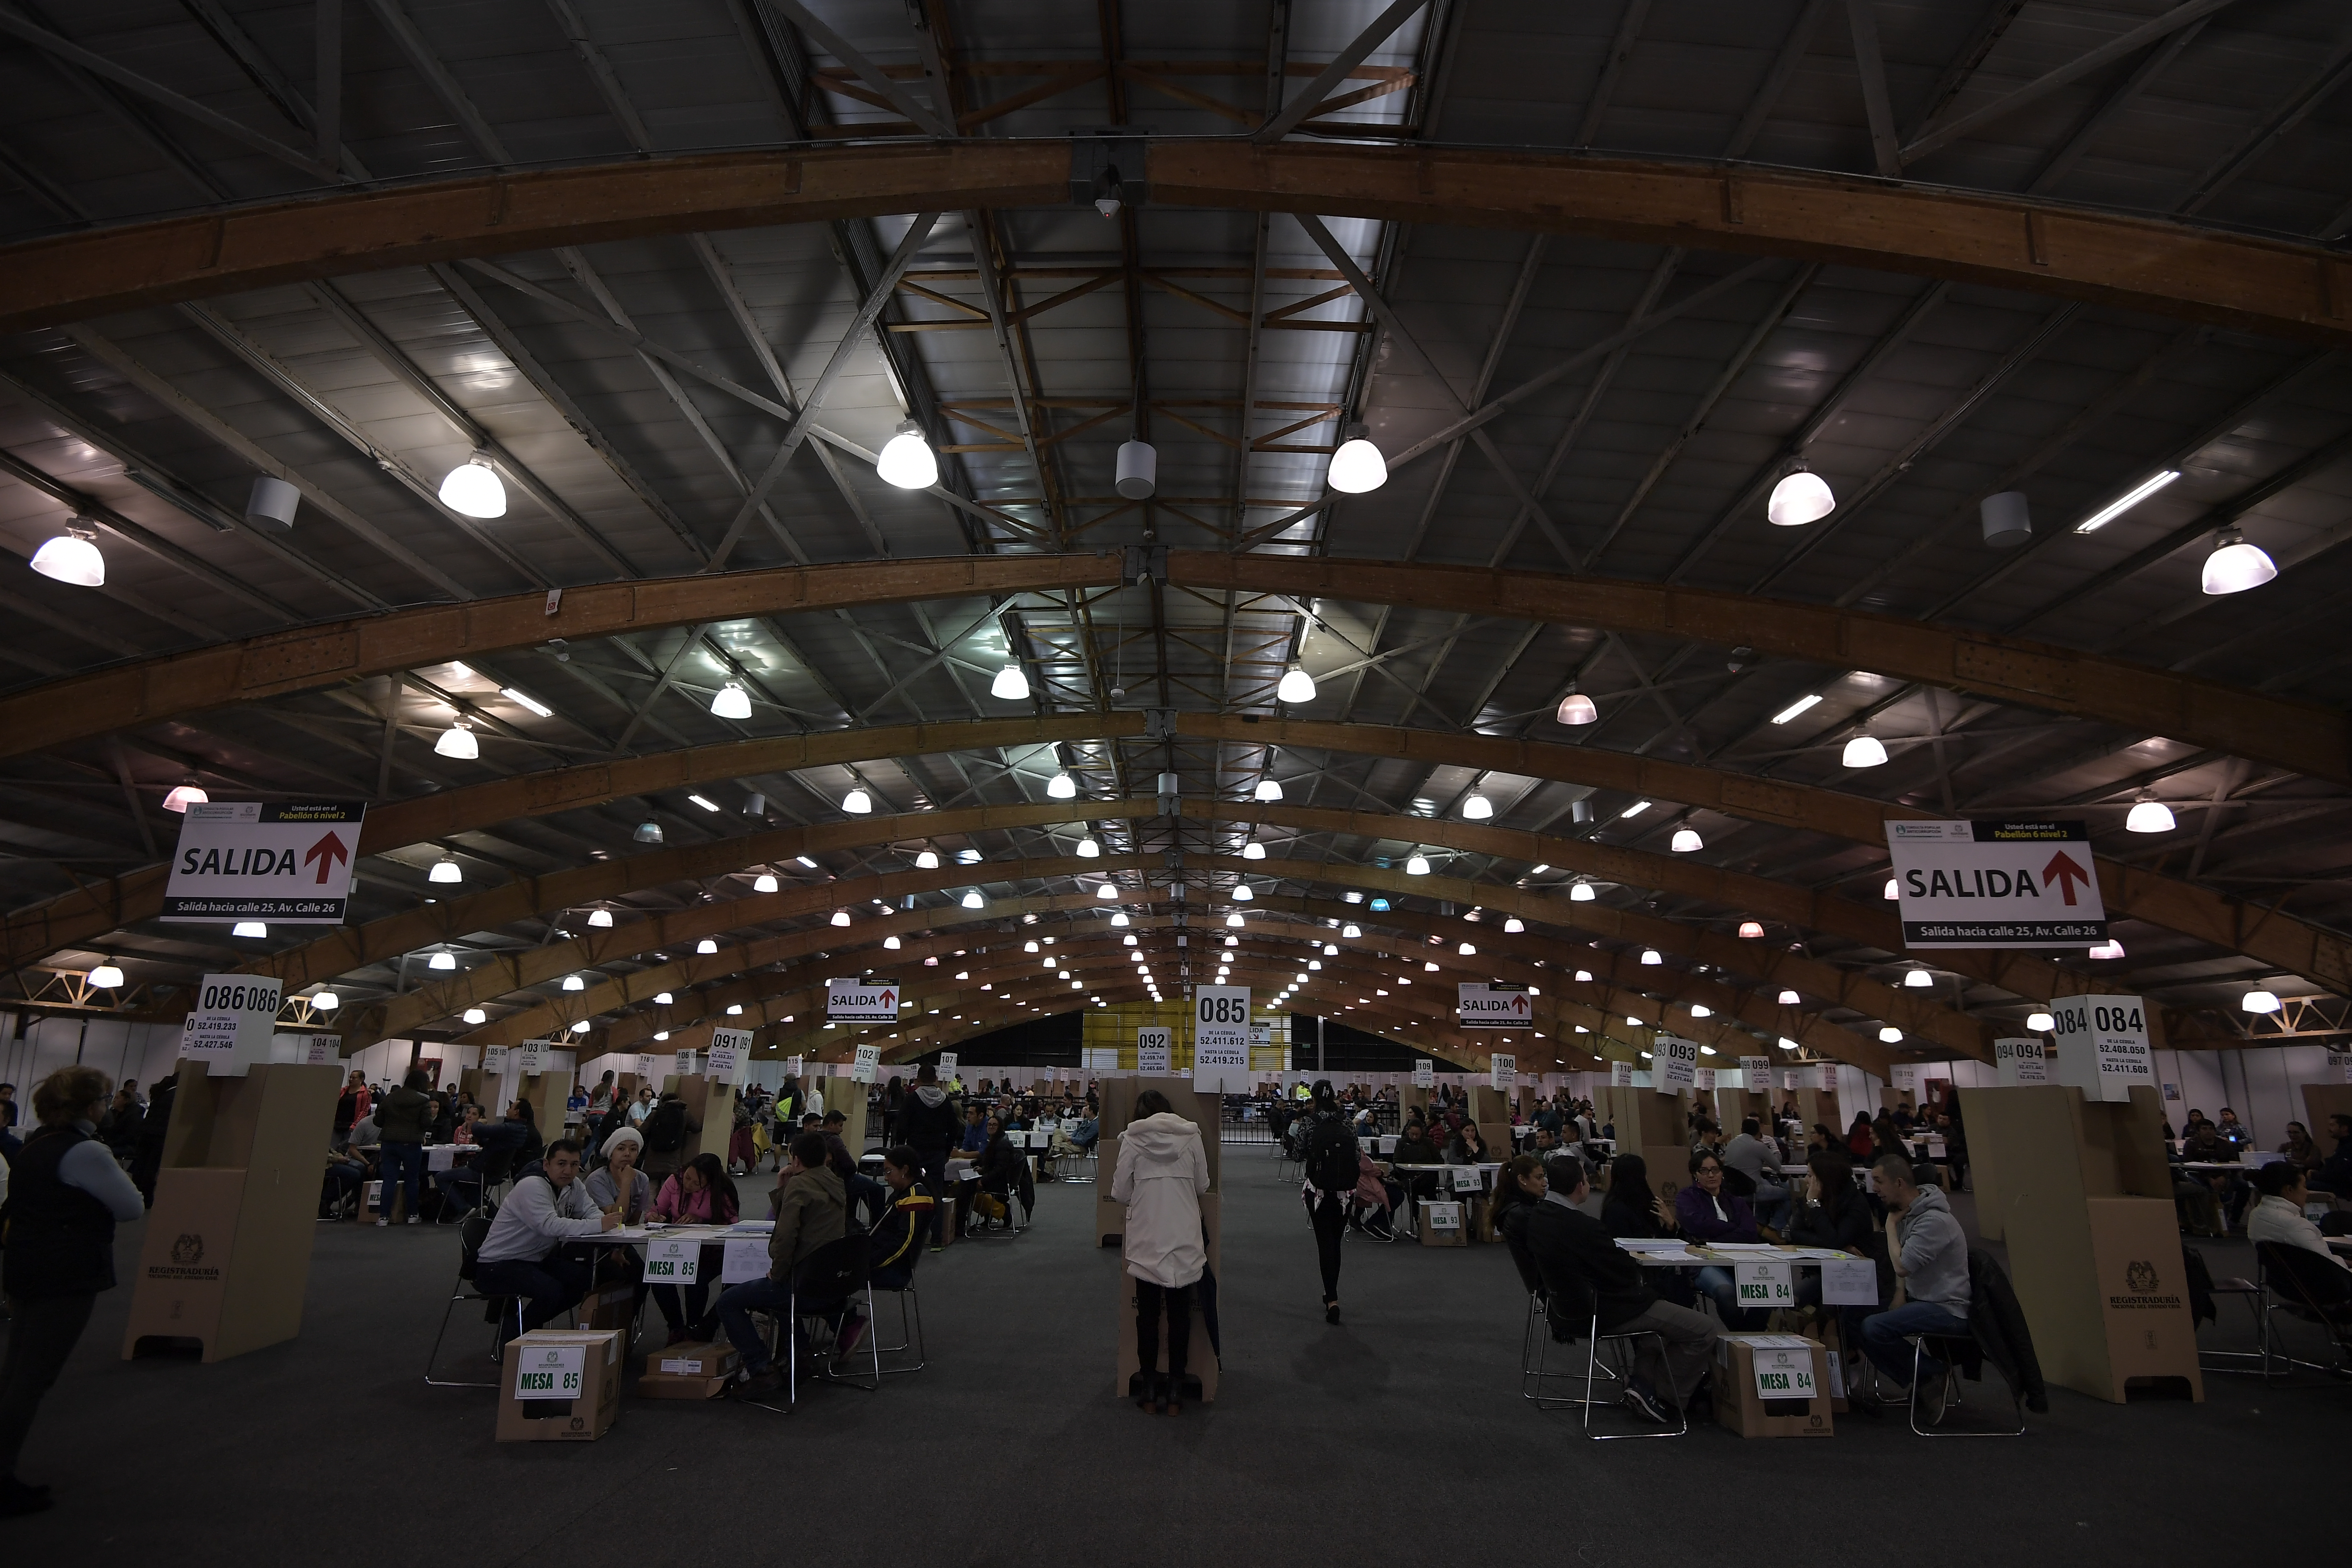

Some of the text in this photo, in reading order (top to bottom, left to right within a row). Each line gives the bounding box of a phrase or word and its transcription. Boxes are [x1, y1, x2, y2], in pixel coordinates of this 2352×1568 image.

[1995, 830, 2031, 838] Pabellón
[181, 848, 297, 875] SALIDA
[1906, 869, 2039, 897] SALIDA
[177, 901, 335, 913] Salida hacia calle 25, Av. Calle 26
[1921, 926, 2097, 937] Salida hacia calle 25, Av. Calle 26
[204, 985, 245, 1010] 086
[247, 987, 278, 1013] 086
[831, 995, 877, 1005] SALIDA
[1200, 997, 1245, 1023] 085
[1463, 1000, 1510, 1011] SALIDA
[2054, 1007, 2087, 1035] 084
[2095, 1007, 2143, 1032] 084
[198, 1022, 237, 1031] 52.419.233
[194, 1040, 233, 1049] 52.427.546
[313, 1038, 327, 1047] 104
[329, 1039, 340, 1048] 104
[714, 1034, 737, 1049] 091
[740, 1037, 751, 1050] 091
[1140, 1034, 1165, 1048] 092
[1200, 1037, 1244, 1045] 52.411.612
[523, 1043, 538, 1052] 103
[540, 1044, 549, 1053] 103
[1654, 1043, 1666, 1057] 093
[1670, 1043, 1695, 1061] 093
[1997, 1045, 2013, 1059] 094
[2017, 1044, 2042, 1059] 094
[2099, 1045, 2145, 1054] 52.408.050
[858, 1048, 874, 1059] 102
[1200, 1056, 1244, 1064] 52.419.215
[1498, 1058, 1514, 1068] 100
[1741, 1060, 1750, 1069] 099
[1753, 1060, 1769, 1069] 099
[2328, 1056, 2341, 1065] 097
[1620, 1064, 1631, 1073] 110
[1668, 1064, 1693, 1073] 52.465.606
[2102, 1064, 2148, 1074] 52.411.608
[1667, 1074, 1692, 1083] 52.471.444
[1456, 1180, 1470, 1188] MESA
[1433, 1217, 1447, 1225] MESA
[149, 1266, 219, 1276] REGISTRADURÍA
[648, 1260, 695, 1275] MESA 85
[1740, 1284, 1790, 1298] MESA 84
[2110, 1294, 2180, 1304] REGISTRADURÍA
[520, 1372, 579, 1389] MESA 85
[1759, 1373, 1811, 1389] MESA 84
